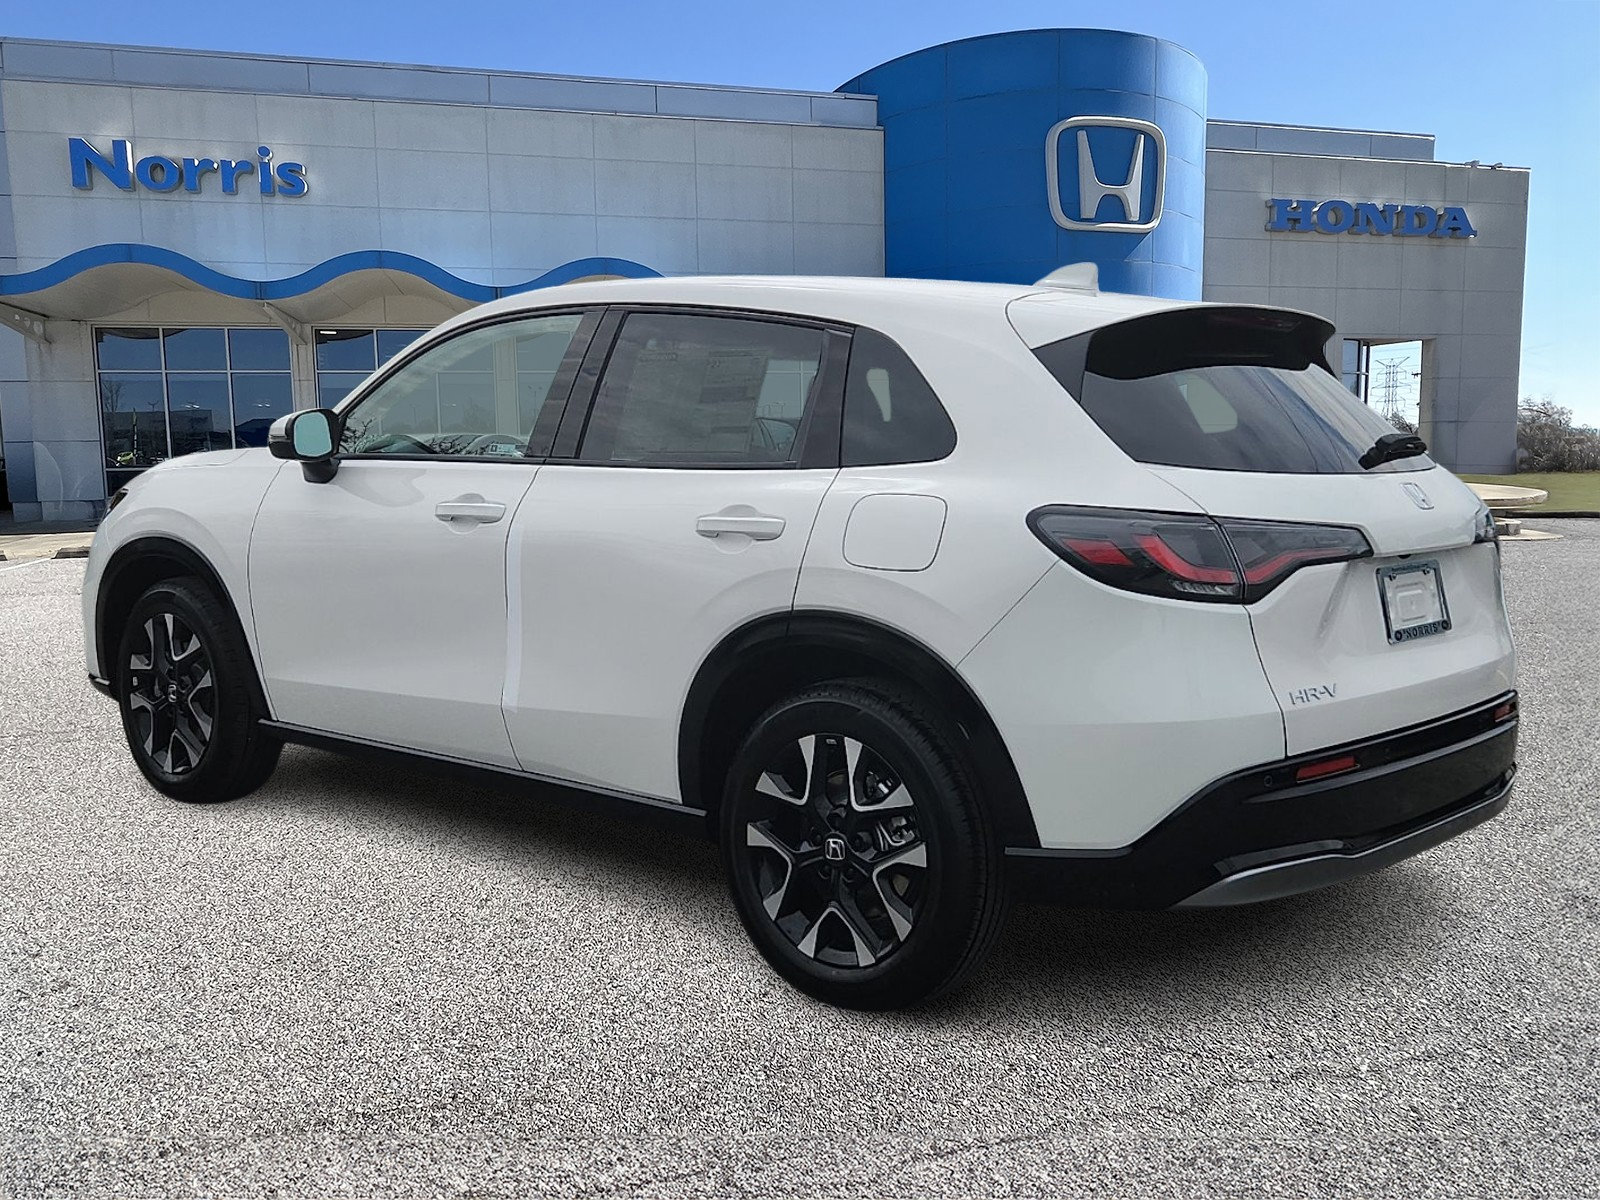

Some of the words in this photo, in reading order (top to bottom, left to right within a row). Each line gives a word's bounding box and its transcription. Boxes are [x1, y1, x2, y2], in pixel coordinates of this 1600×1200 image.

[68, 137, 309, 196] Norris
[1265, 198, 1478, 239] HONDA
[1288, 683, 1337, 705] HR-V
